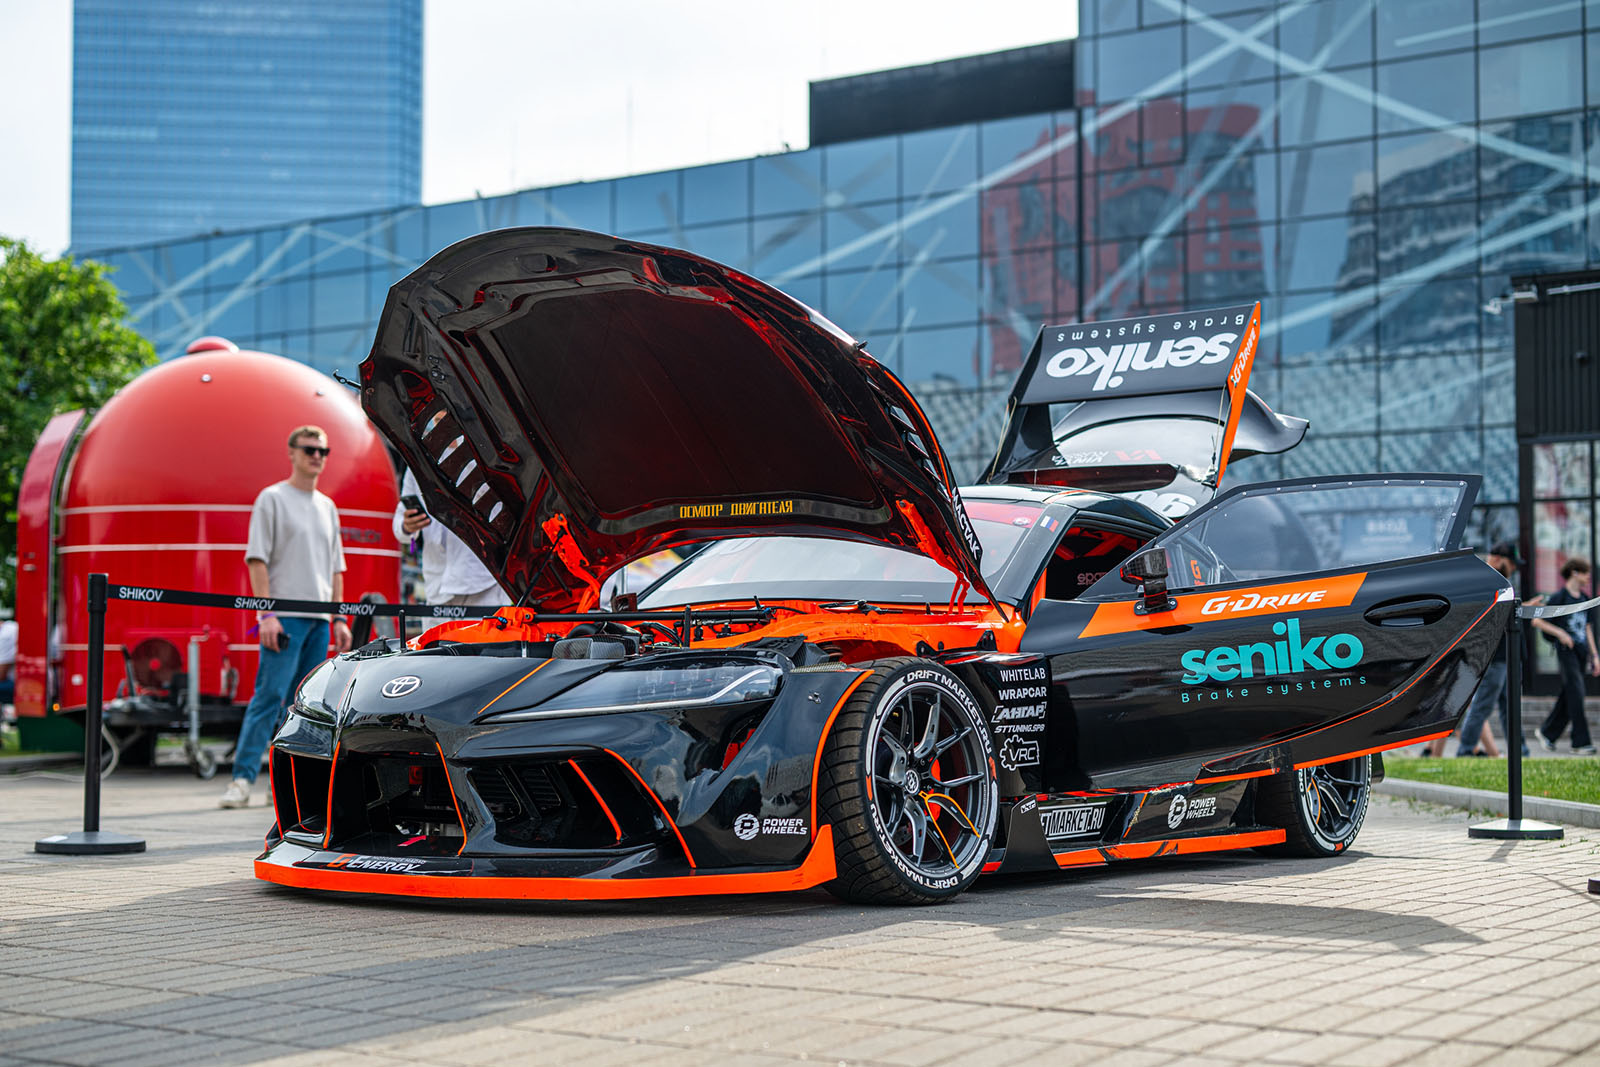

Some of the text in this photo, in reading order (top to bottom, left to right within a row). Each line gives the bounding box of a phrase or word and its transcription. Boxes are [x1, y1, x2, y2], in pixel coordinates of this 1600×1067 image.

[1057, 314, 1245, 341] Brake systems
[1046, 332, 1238, 391] seniko
[679, 500, 793, 518] ОСМОТР ДВИГАТЕЛЯ
[118, 586, 467, 617] SHIKOV SHIKOV SHIKOV SHIKOV
[1181, 618, 1364, 685] seniko
[1000, 668, 1046, 682] WHITELAB
[998, 686, 1047, 700] WRAPCAR
[1181, 676, 1367, 703] Brake systems
[1009, 747, 1036, 761] VRC
[1189, 797, 1216, 810] POWER
[1185, 807, 1216, 820] WHEELS
[763, 818, 804, 827] POWER
[762, 826, 808, 835] WHEELS
